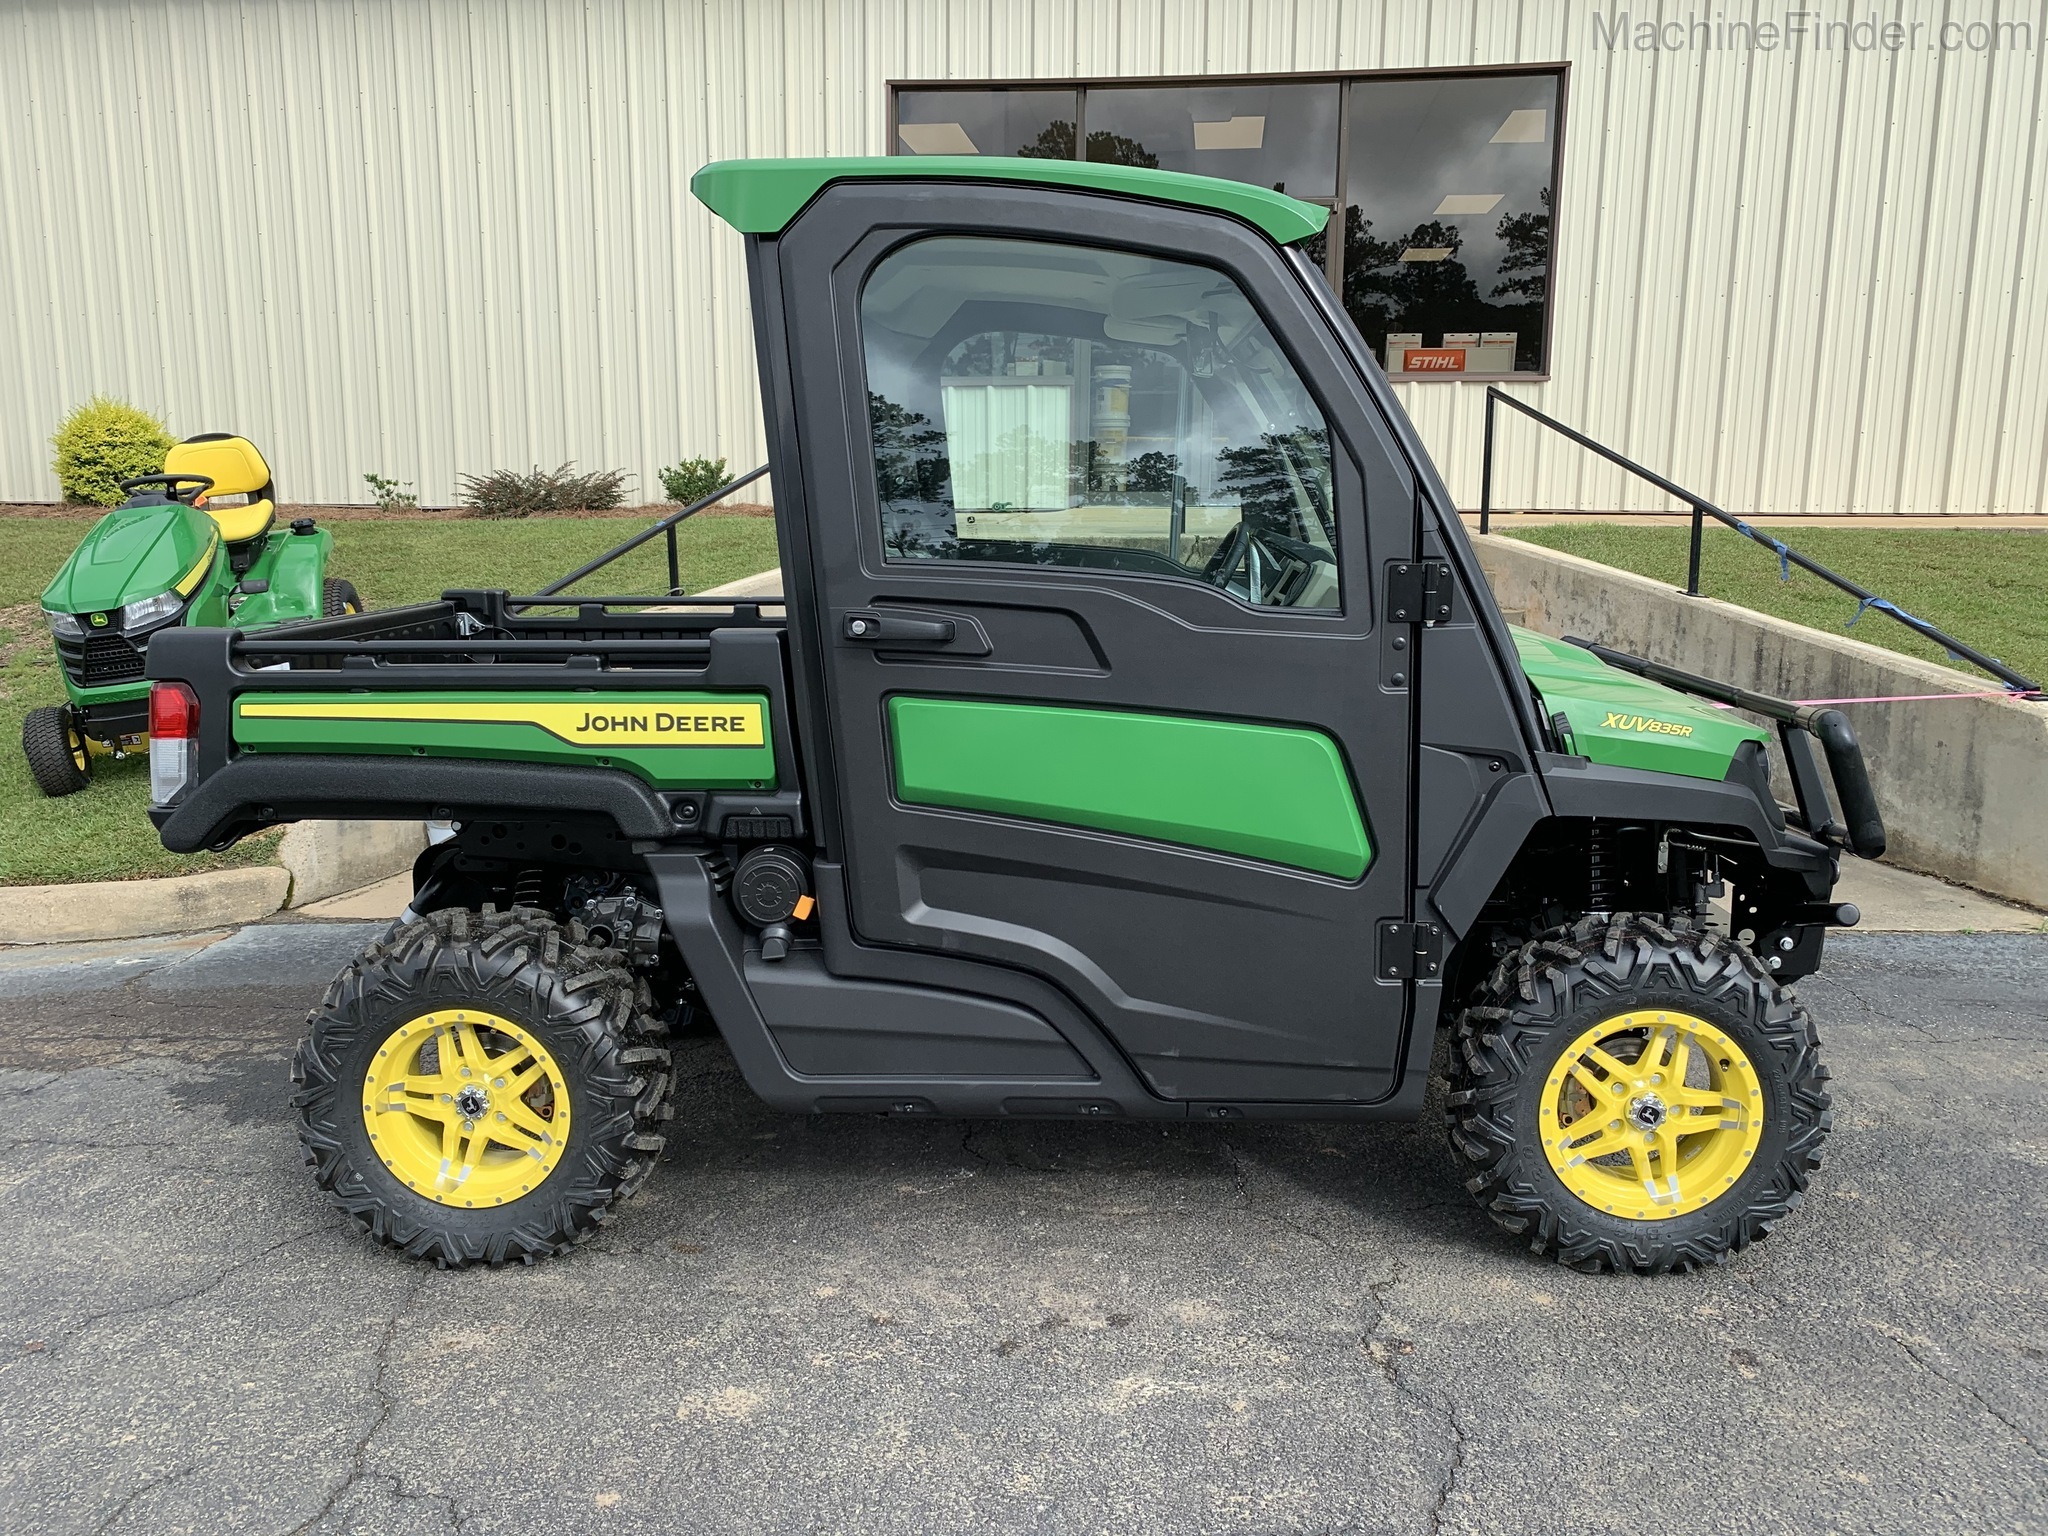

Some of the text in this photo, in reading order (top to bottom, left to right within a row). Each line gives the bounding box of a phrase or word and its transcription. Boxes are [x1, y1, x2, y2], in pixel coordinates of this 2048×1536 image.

[1408, 356, 1459, 369] STIHL
[576, 712, 745, 732] JOHN DEERE
[1600, 711, 1694, 738] XUV835R
